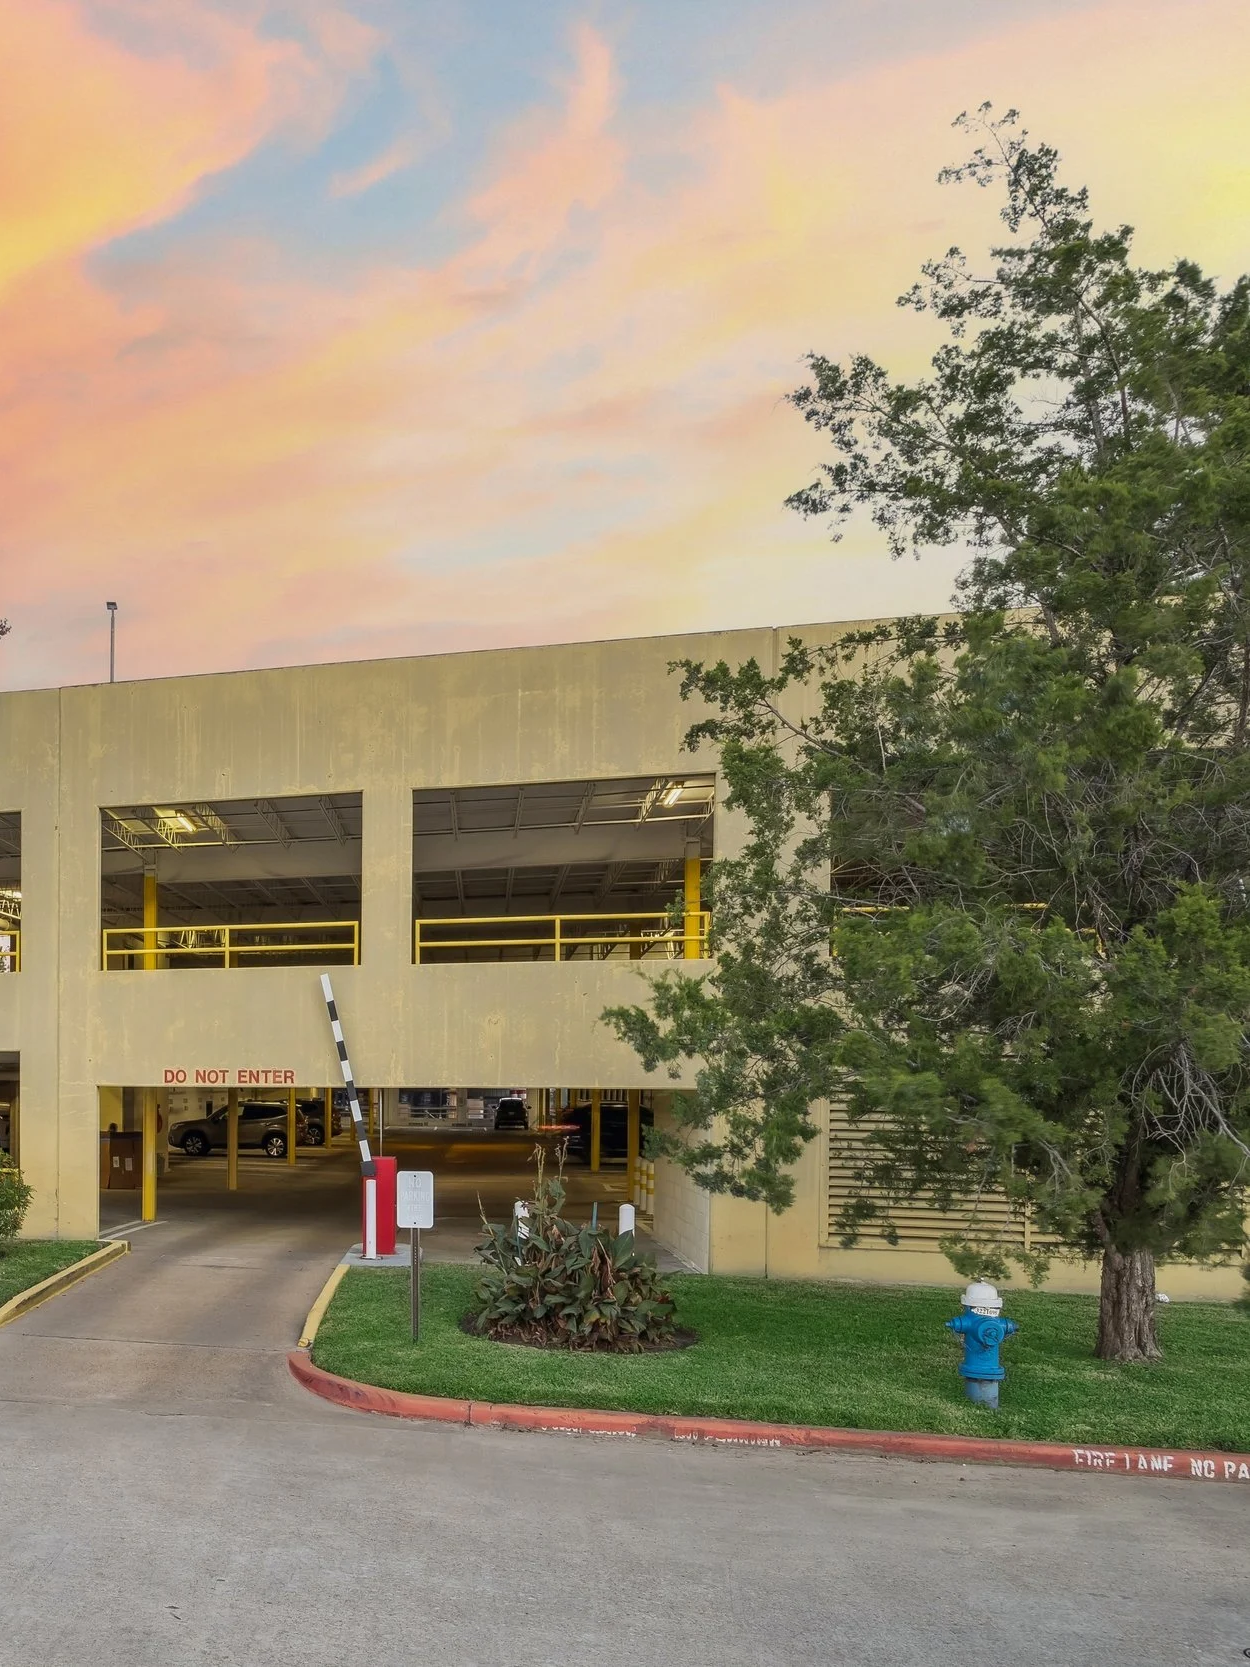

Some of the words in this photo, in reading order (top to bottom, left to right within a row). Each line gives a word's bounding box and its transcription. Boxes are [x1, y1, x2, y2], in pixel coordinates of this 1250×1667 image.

[164, 1069, 187, 1084] DO
[195, 1069, 229, 1084] NOT
[237, 1069, 295, 1084] ENTER
[408, 1176, 422, 1188] NO
[400, 1190, 430, 1202] PARKING
